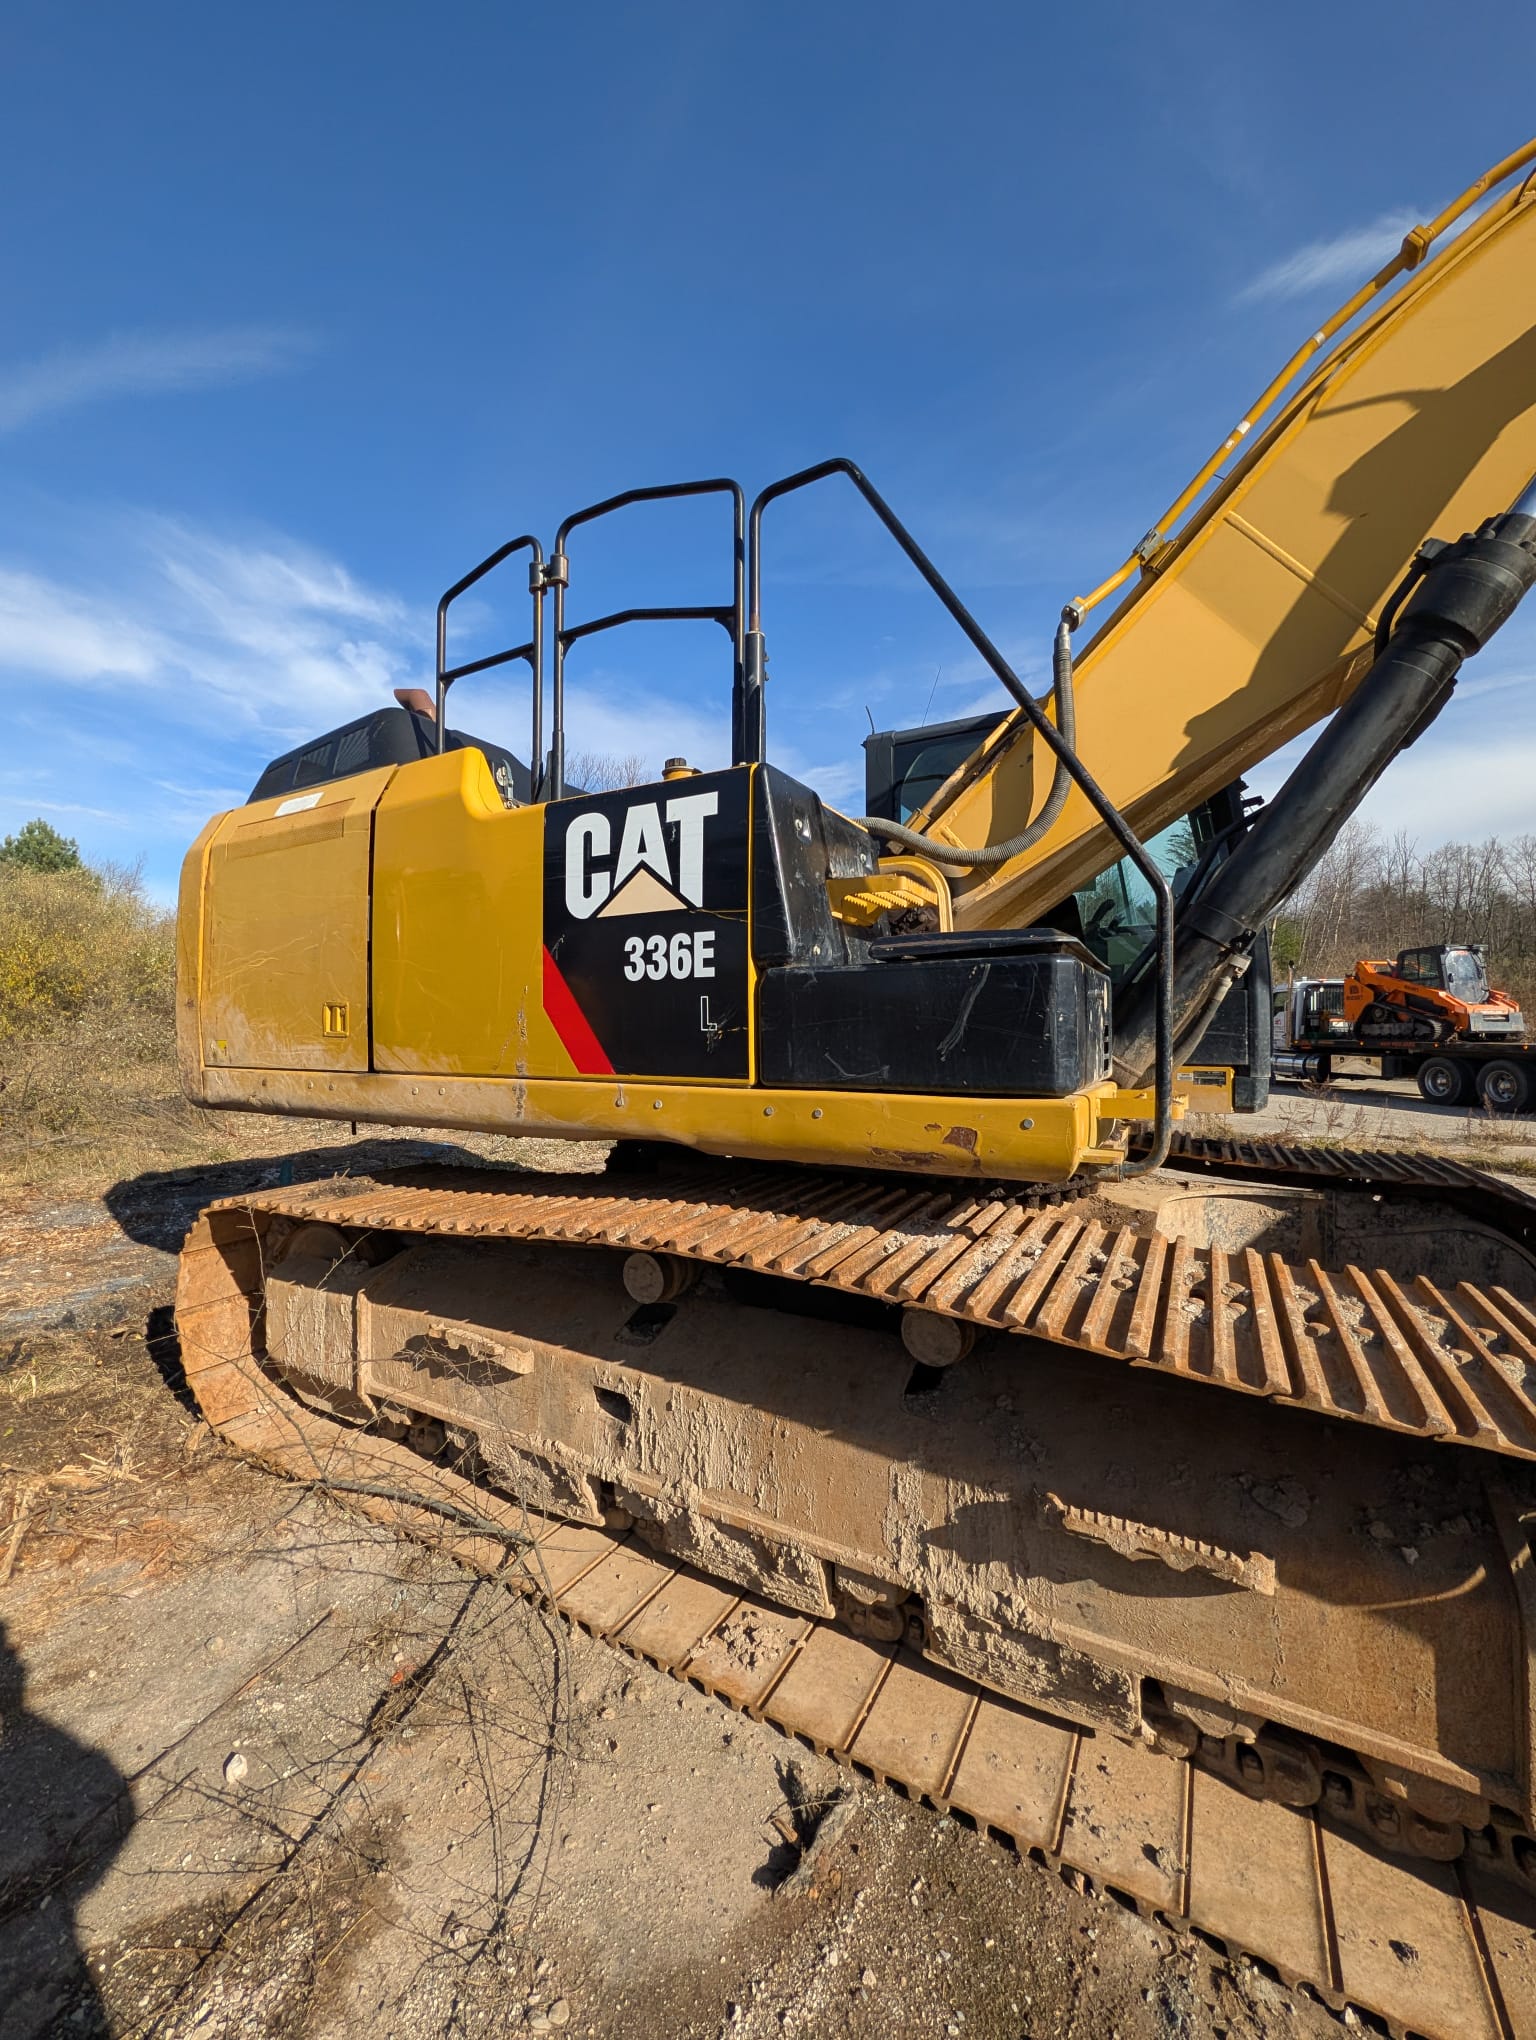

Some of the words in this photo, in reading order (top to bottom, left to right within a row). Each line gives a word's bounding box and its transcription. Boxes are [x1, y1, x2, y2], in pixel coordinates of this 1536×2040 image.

[566, 791, 718, 920] CAT
[624, 930, 715, 982] 336E
[700, 995, 717, 1031] L
